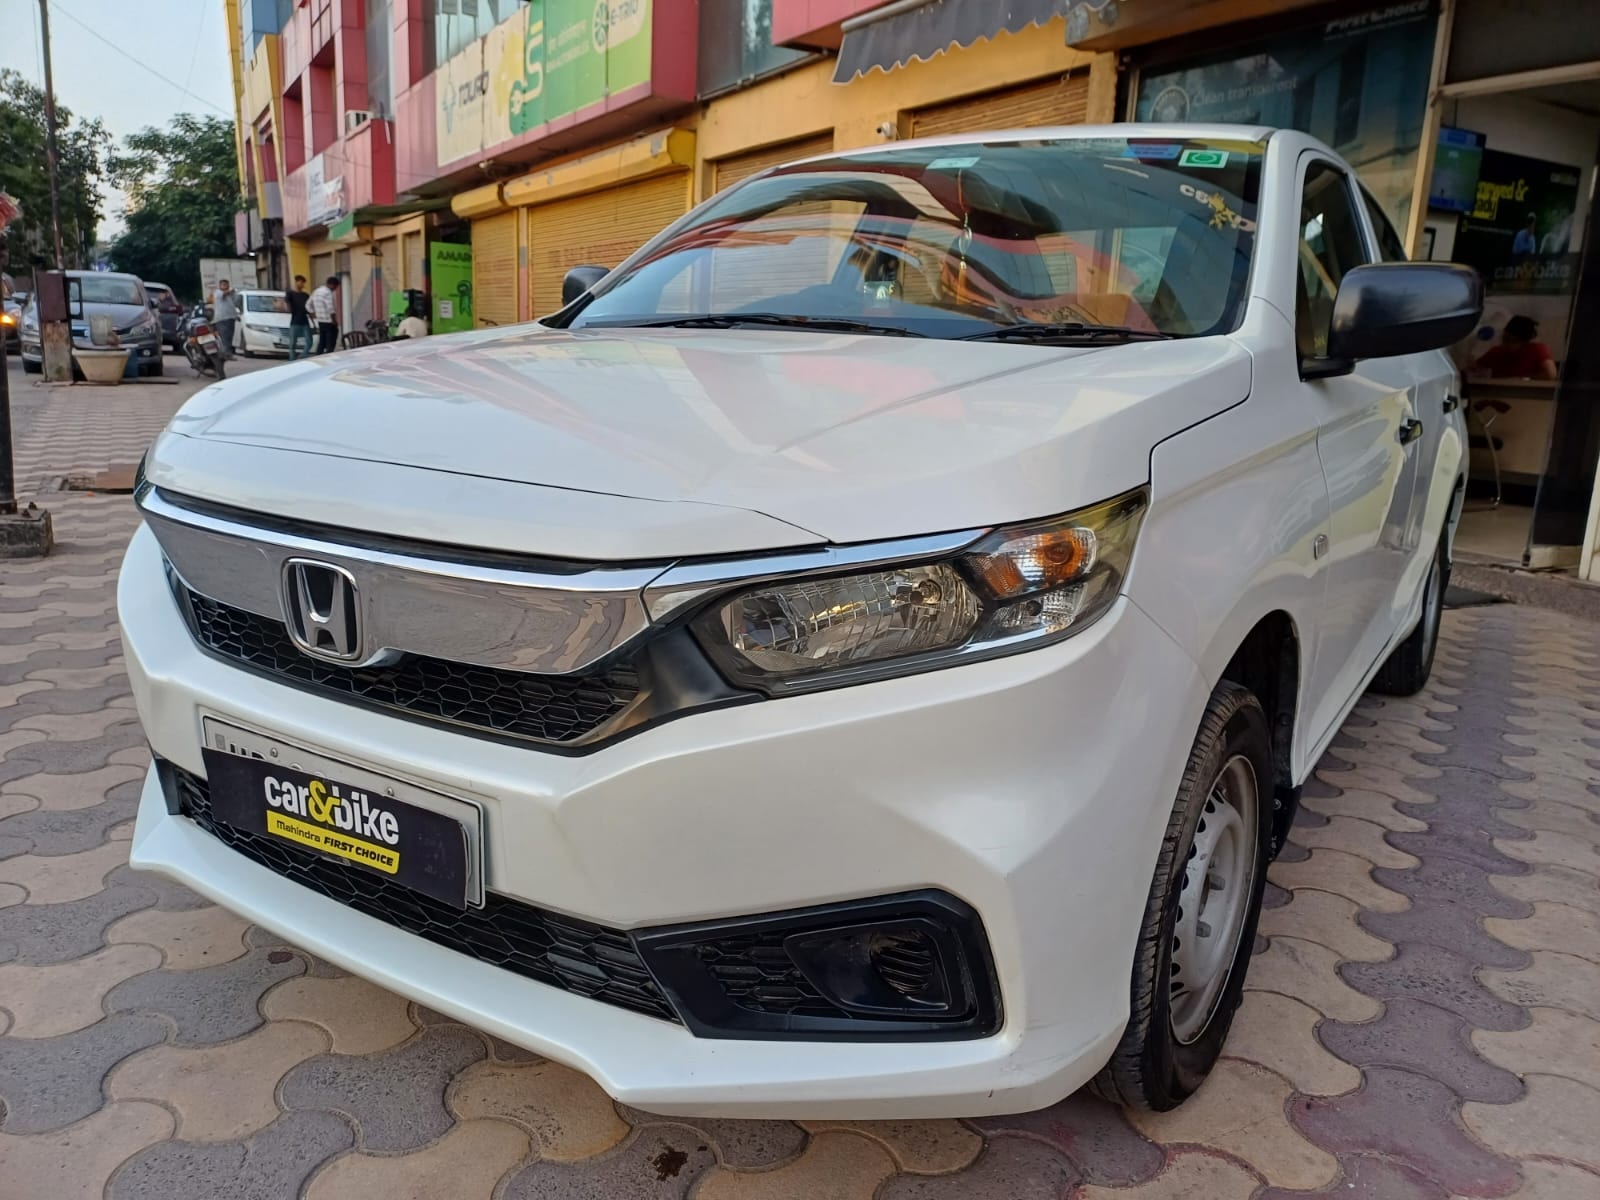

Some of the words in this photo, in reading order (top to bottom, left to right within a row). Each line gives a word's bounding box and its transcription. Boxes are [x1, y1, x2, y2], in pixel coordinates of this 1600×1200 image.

[264, 776, 400, 846] car&bike
[323, 836, 354, 854] FIRST
[355, 846, 394, 867] CHOICE
